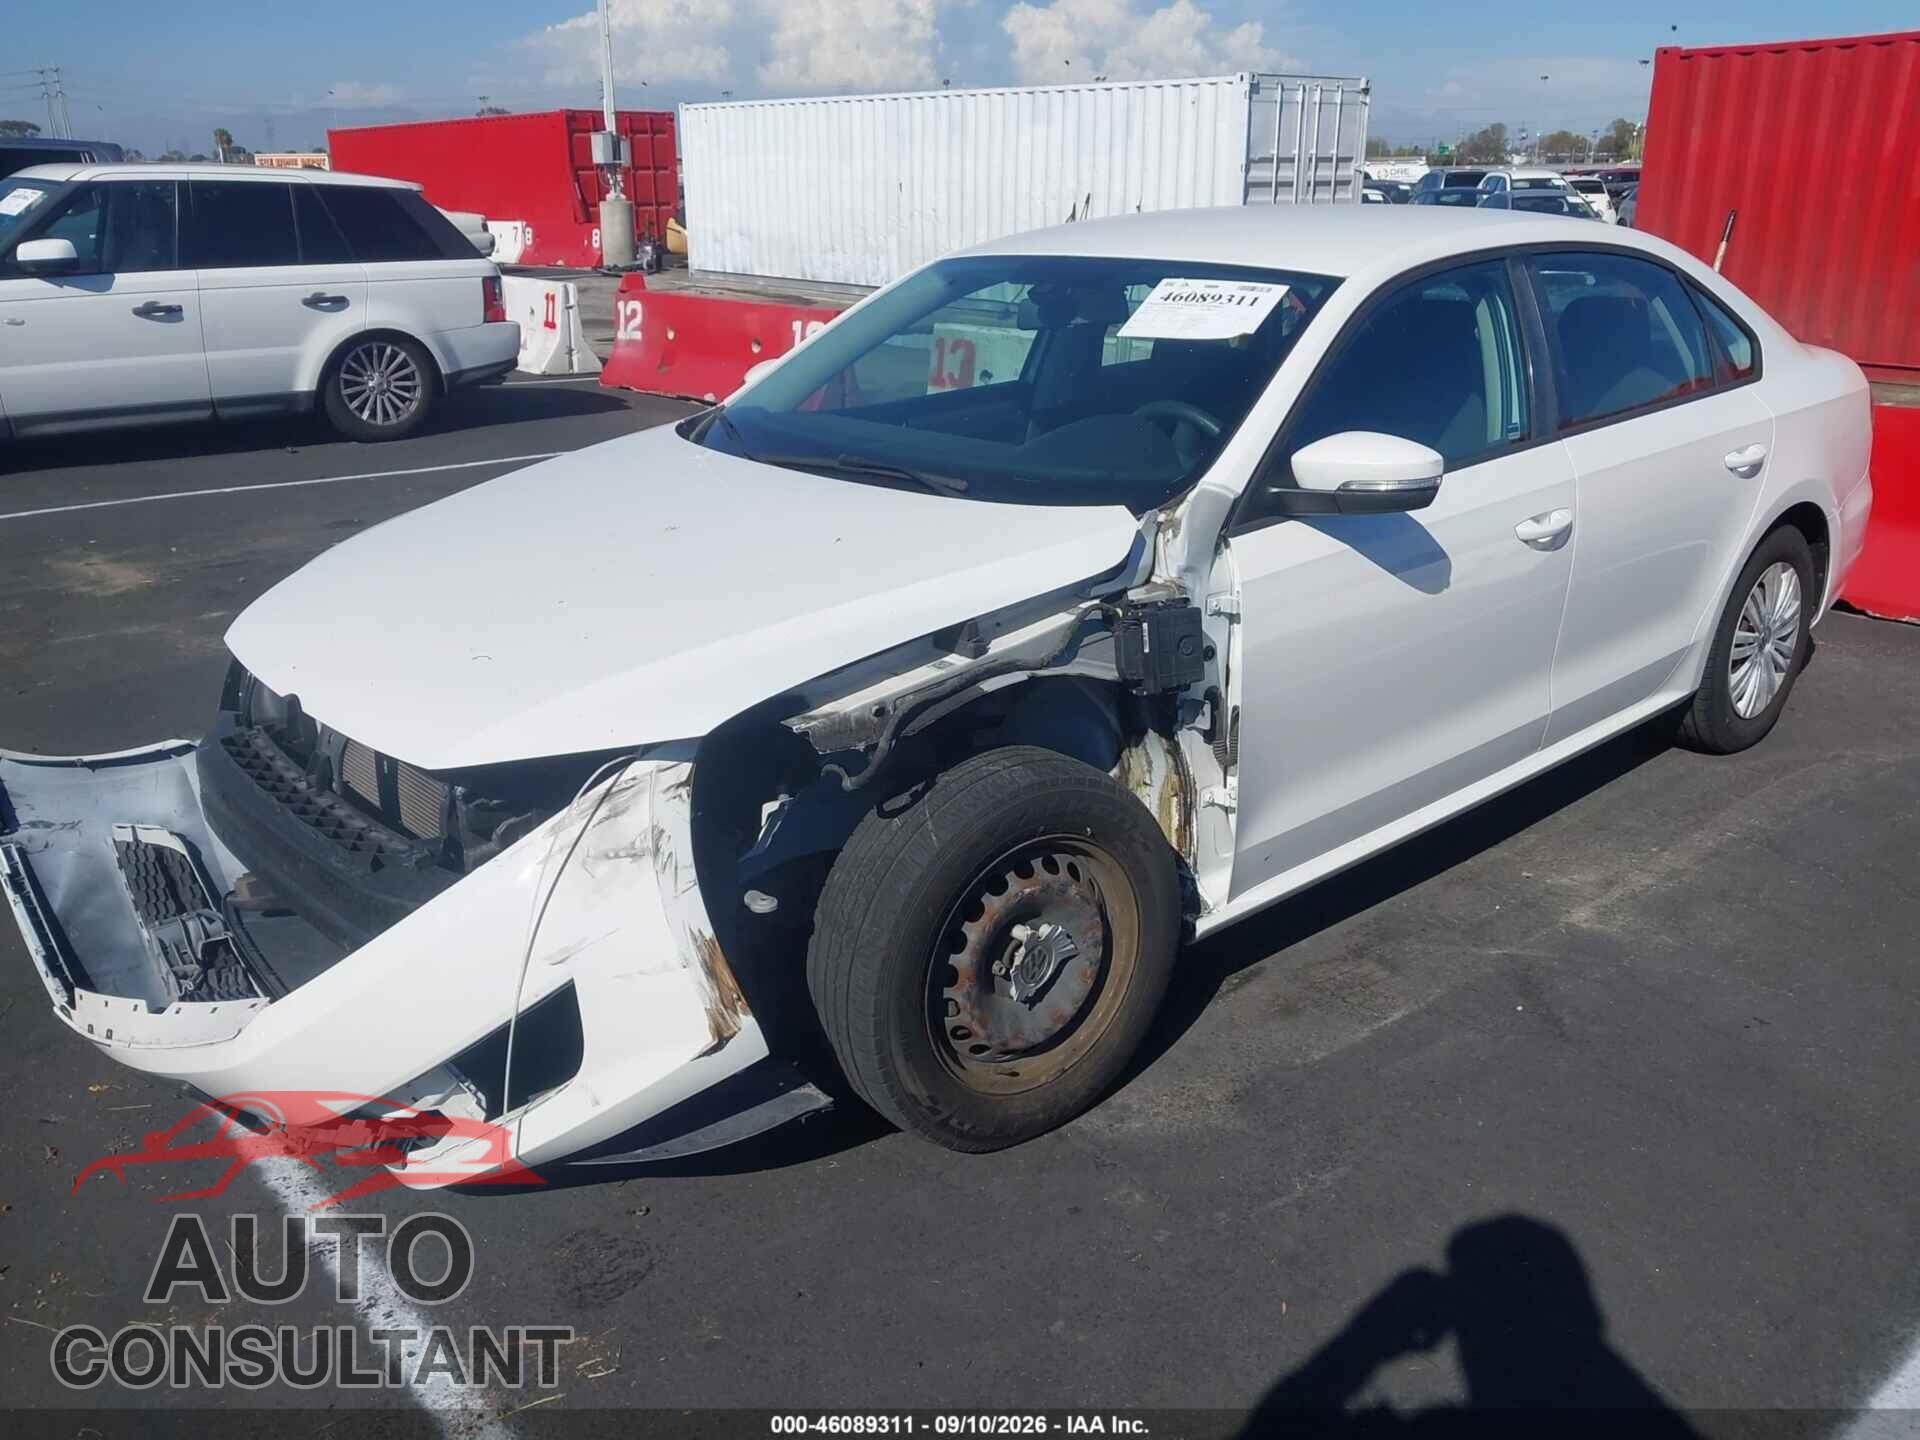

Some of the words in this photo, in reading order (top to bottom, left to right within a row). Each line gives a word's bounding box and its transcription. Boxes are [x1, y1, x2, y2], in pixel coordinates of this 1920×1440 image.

[513, 226, 519, 243] 7
[525, 227, 532, 245] 8
[592, 228, 600, 248] 8
[1160, 291, 1259, 307] 46089311
[544, 292, 556, 329] 11
[617, 300, 642, 341] 12
